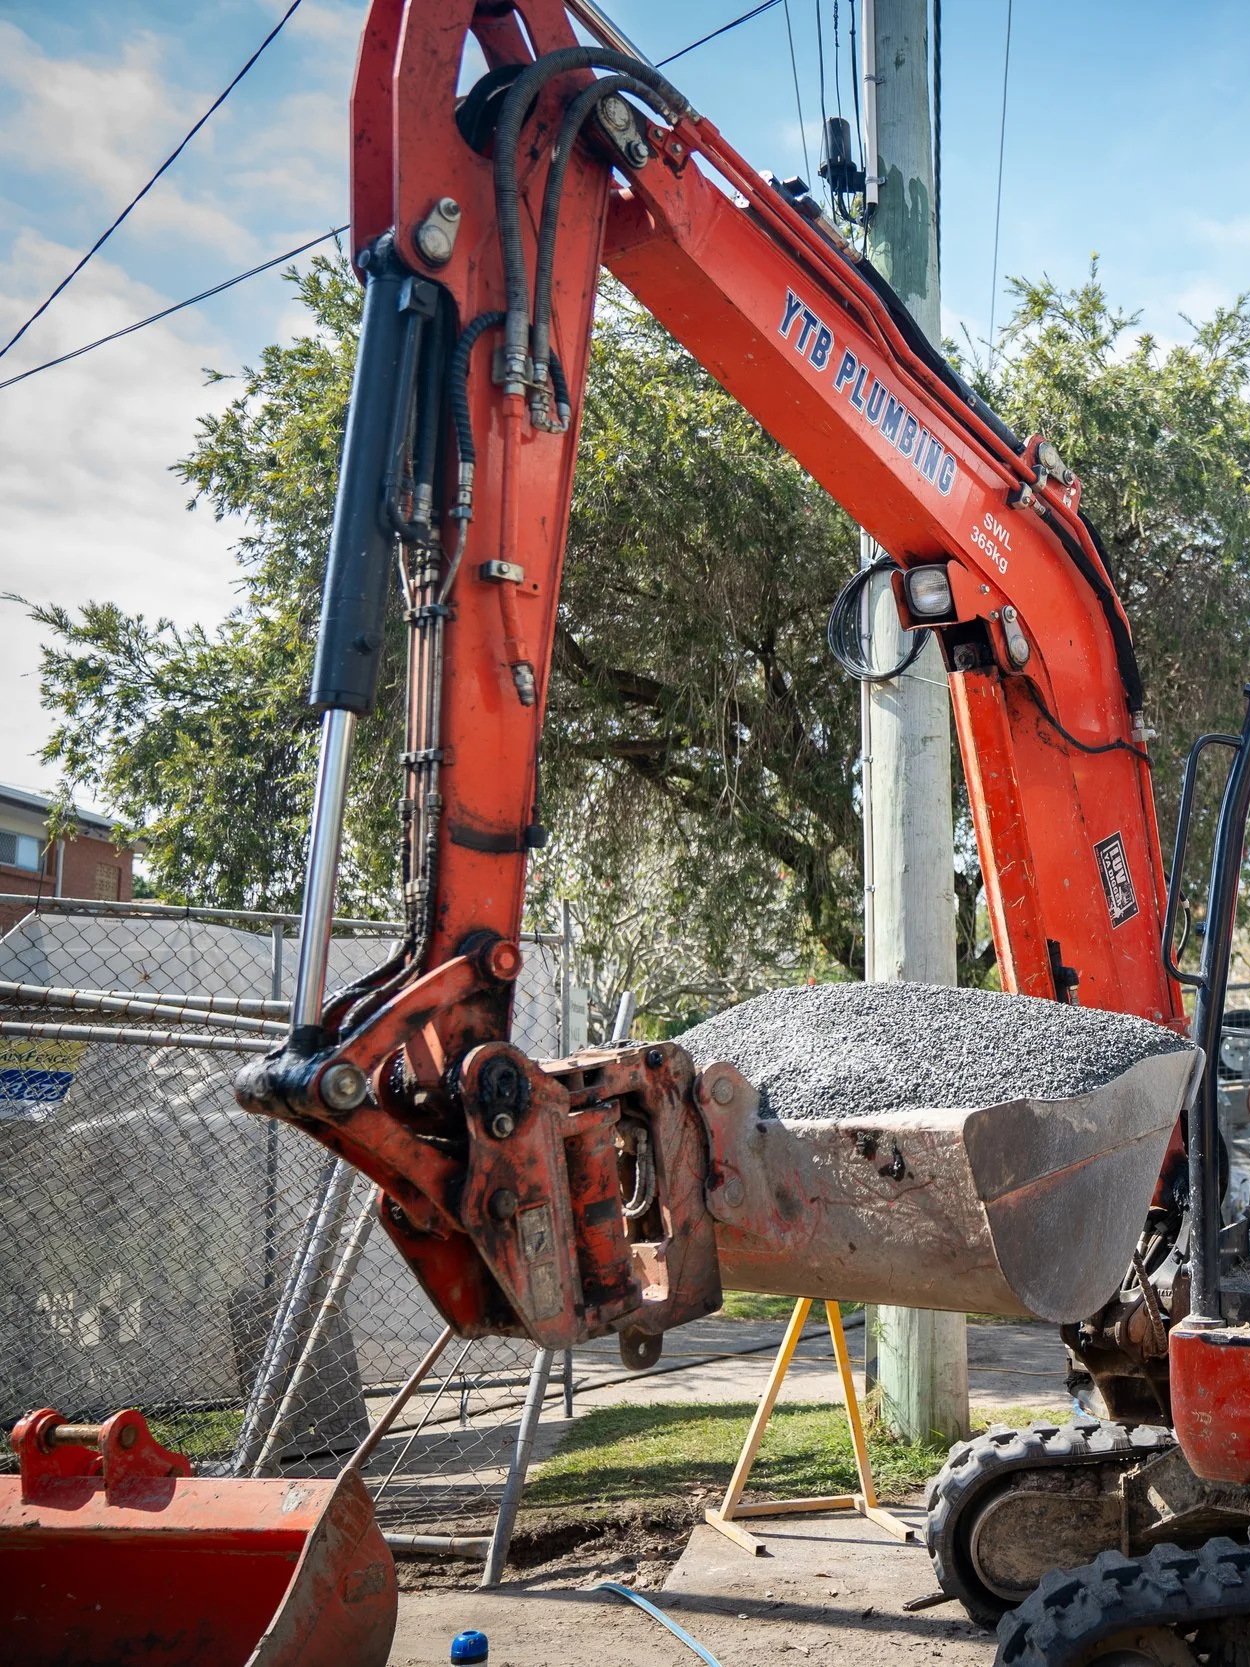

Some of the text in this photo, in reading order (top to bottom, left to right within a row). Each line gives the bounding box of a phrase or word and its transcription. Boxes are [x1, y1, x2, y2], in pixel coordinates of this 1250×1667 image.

[777, 285, 958, 497] YTB PLUMBING
[970, 526, 1009, 574] 365kg
[983, 512, 1013, 552] SWL
[1110, 846, 1127, 884] LUV
